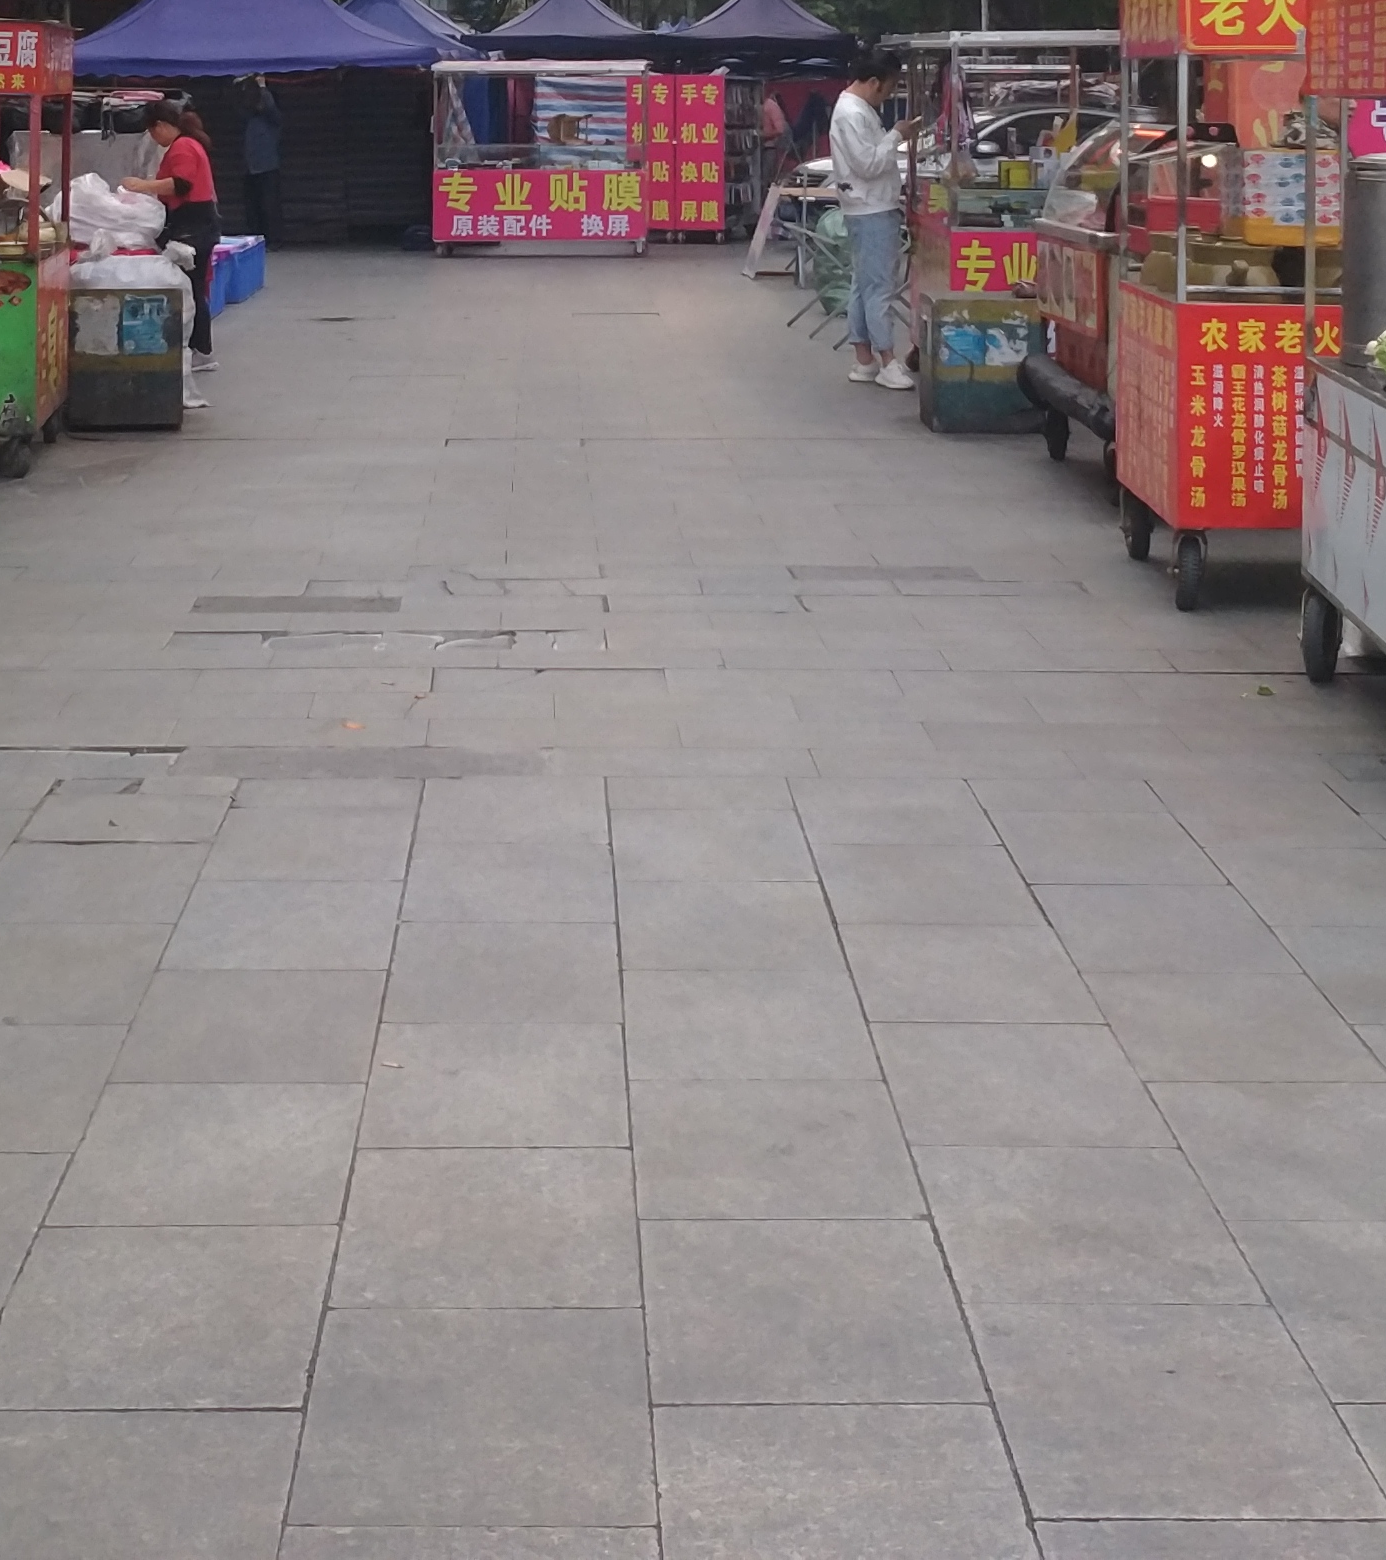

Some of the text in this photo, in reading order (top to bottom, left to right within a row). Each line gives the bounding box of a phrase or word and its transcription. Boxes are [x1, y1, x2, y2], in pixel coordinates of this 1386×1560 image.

[438, 172, 643, 213] 专业贴膜
[651, 83, 670, 222] 专业贴膜
[680, 83, 699, 222] 手机换屏
[701, 83, 719, 223] 专业贴膜
[450, 214, 630, 237] 原装配件 换屏
[956, 239, 1037, 292] 专业
[1199, 318, 1341, 354] 农家老火
[1190, 364, 1207, 508] 玉米龙骨汤
[1271, 365, 1288, 510] 茶树菇龙骨汤
